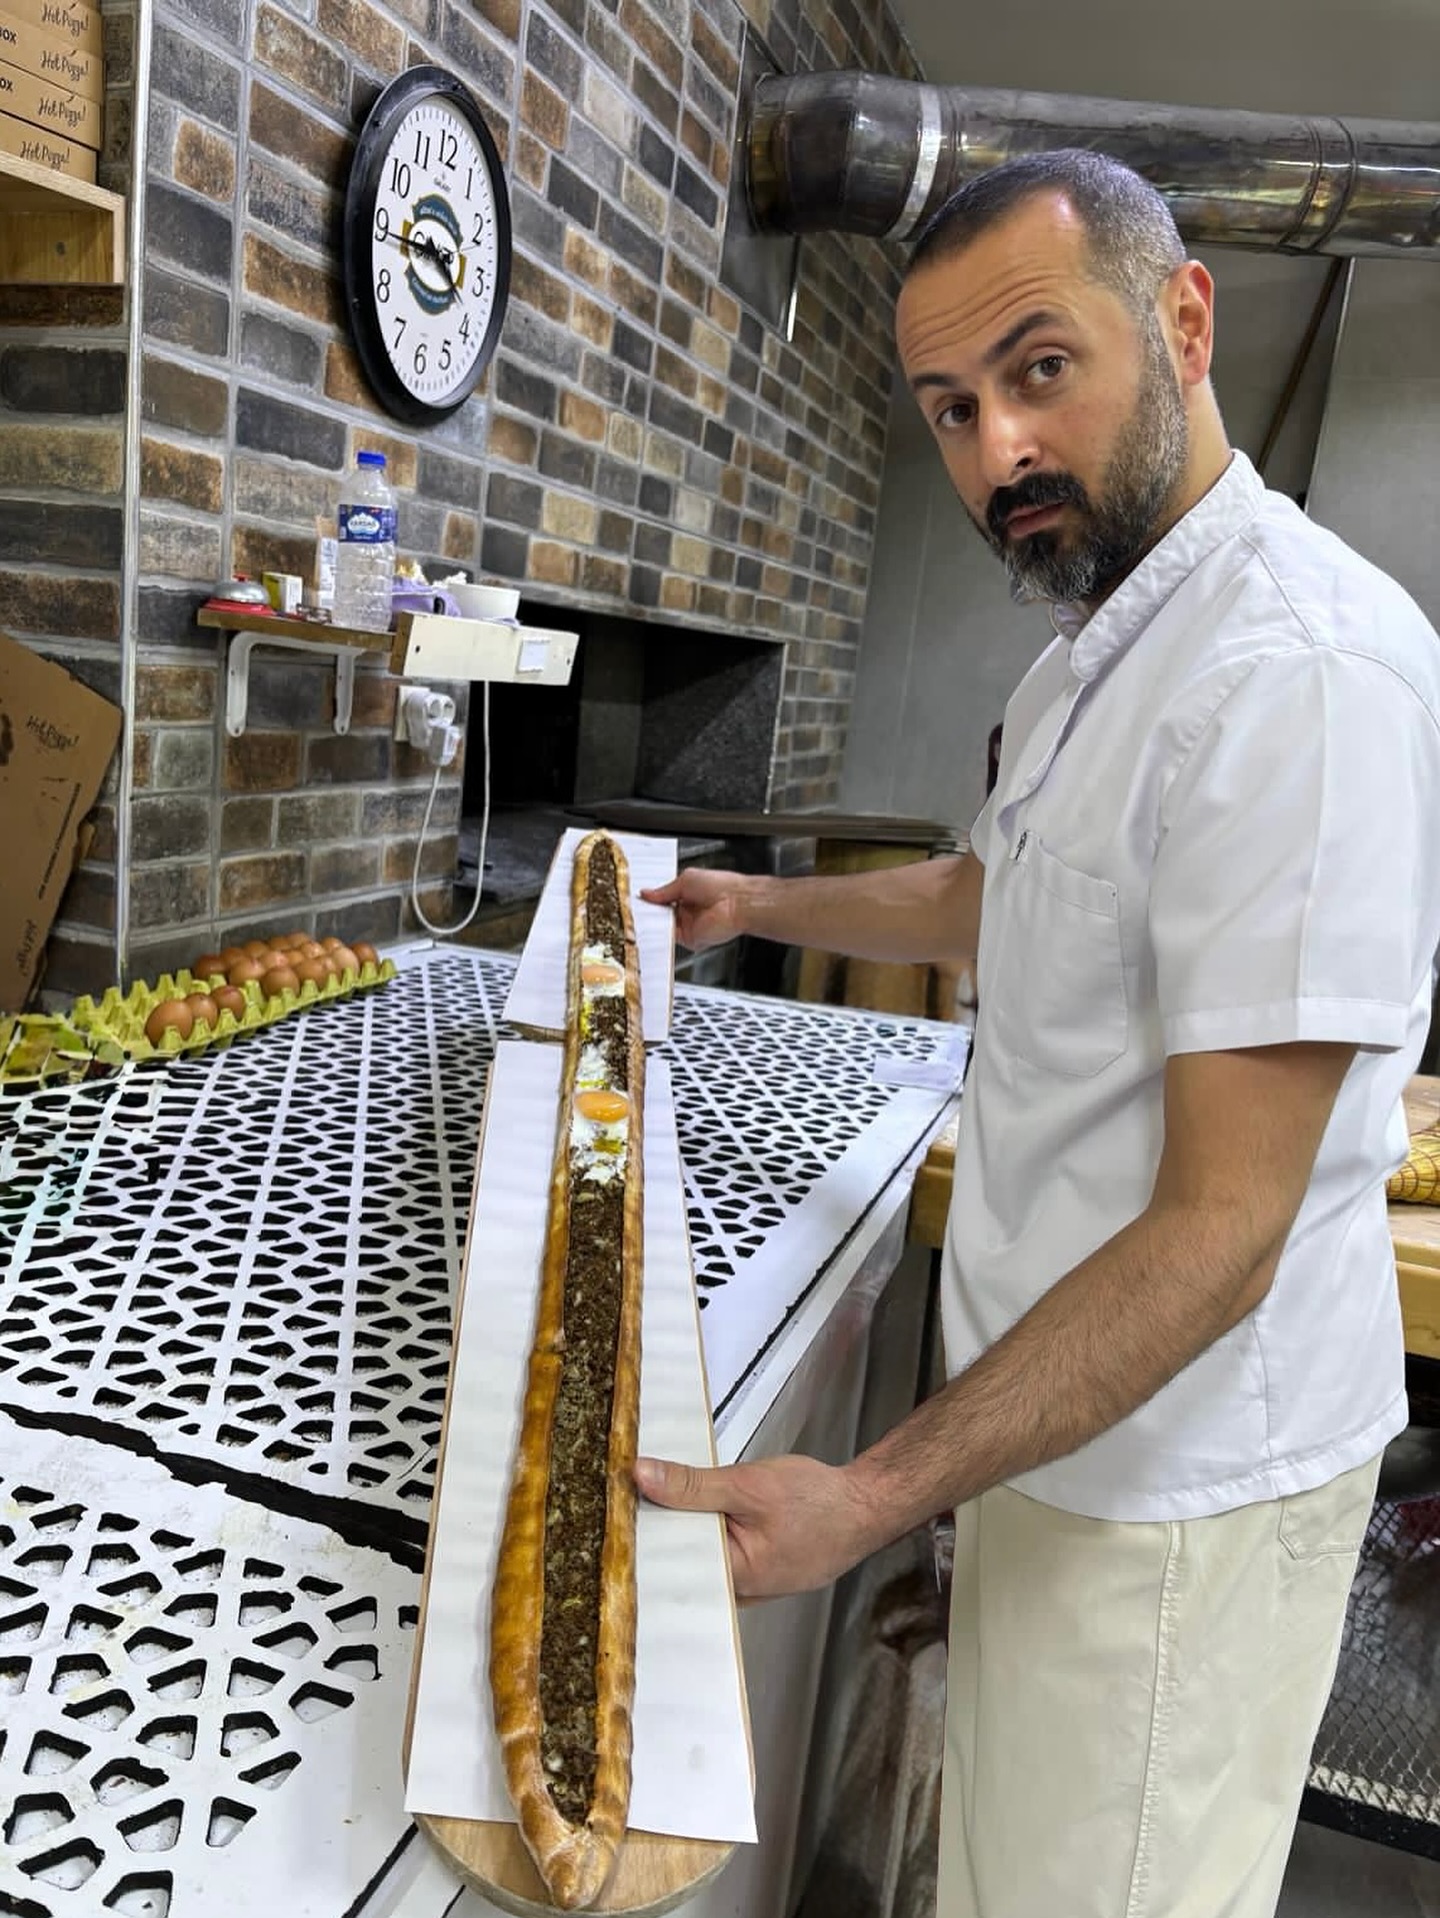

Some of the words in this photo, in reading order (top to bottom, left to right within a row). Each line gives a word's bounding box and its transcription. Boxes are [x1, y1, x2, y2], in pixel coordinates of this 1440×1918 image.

[41, 4, 60, 25] Hot
[0, 25, 17, 44] OX
[41, 50, 60, 71] Hot
[38, 98, 57, 116] Hot
[19, 141, 42, 162] Hot
[414, 130, 431, 171] 11
[438, 128, 458, 171] 12
[389, 157, 411, 199] 10
[465, 167, 474, 200] 1
[375, 208, 390, 241] 9
[472, 213, 484, 246] 2
[376, 268, 391, 303] 8
[472, 266, 485, 298] 3
[394, 316, 407, 349] 7
[459, 312, 471, 345] 4
[414, 342, 428, 375] 6
[438, 339, 452, 371] 5
